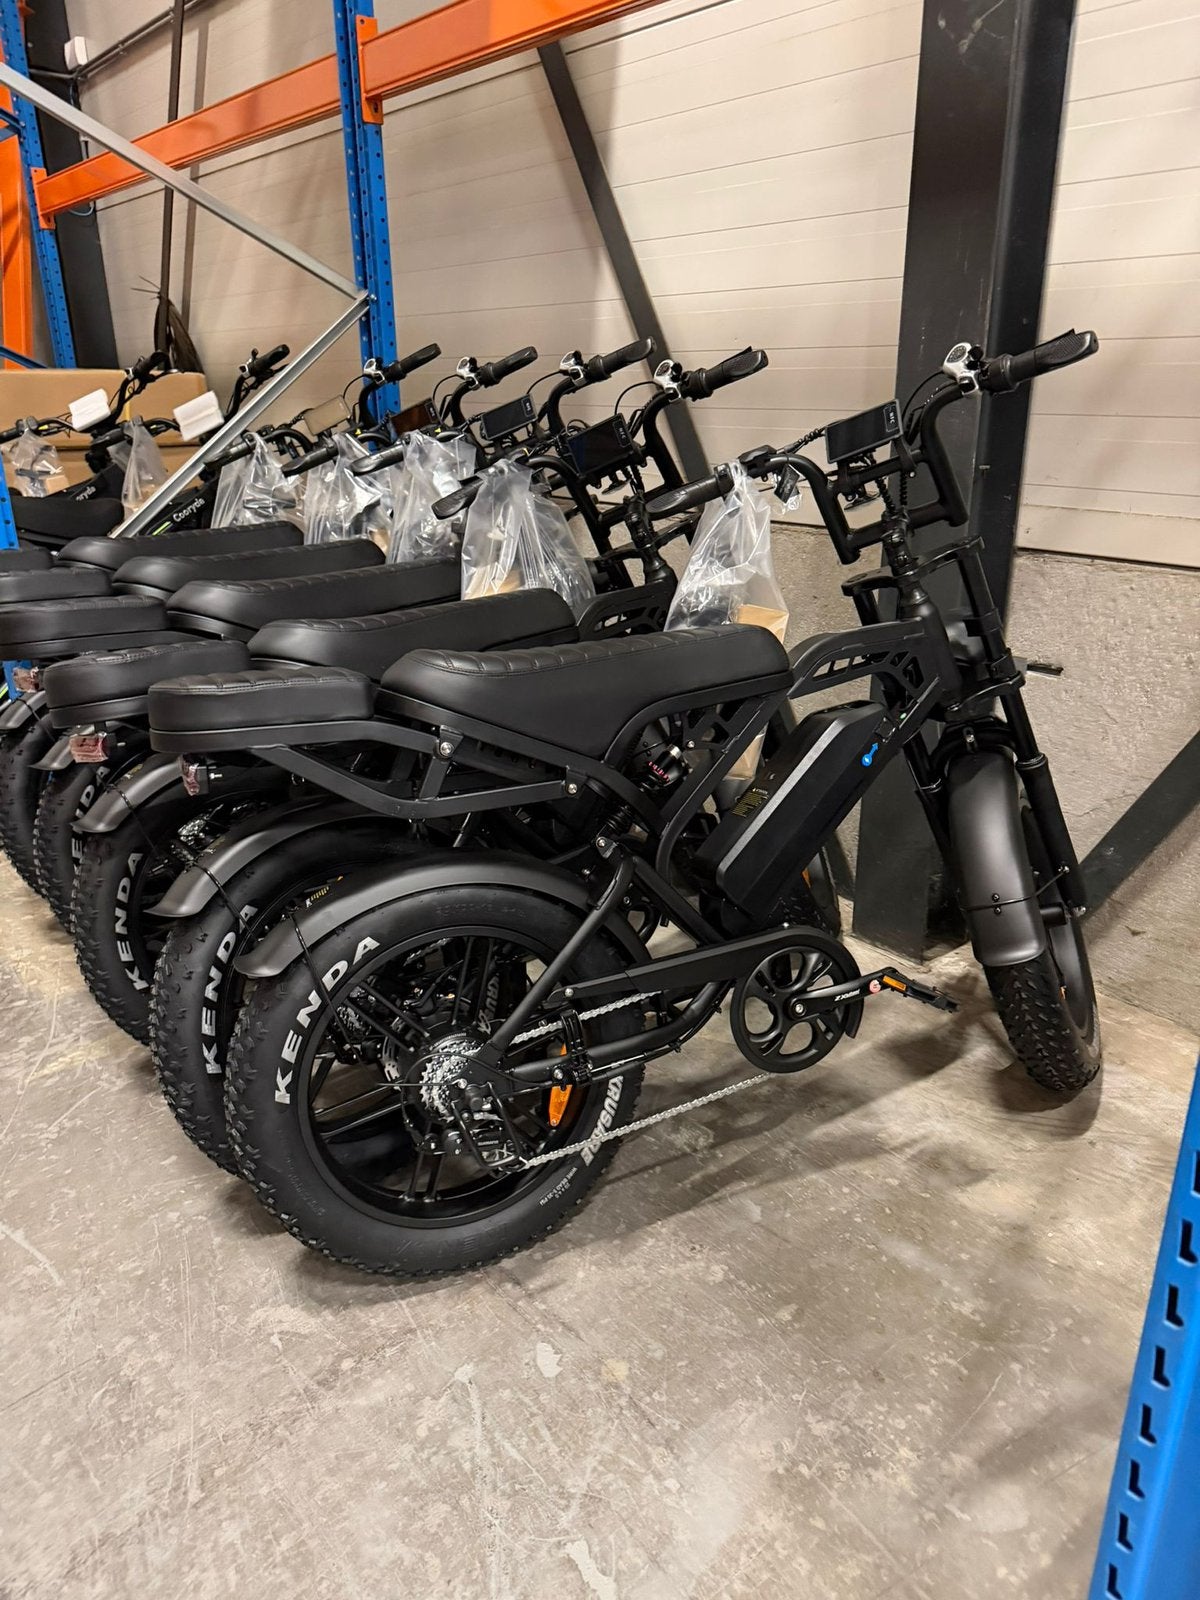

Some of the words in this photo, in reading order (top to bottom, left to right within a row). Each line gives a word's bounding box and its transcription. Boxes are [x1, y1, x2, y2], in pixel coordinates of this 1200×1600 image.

[75, 485, 97, 502] oryda
[114, 852, 150, 991] KENDA
[201, 904, 259, 1075] KENDA
[274, 936, 381, 1105] KENDA
